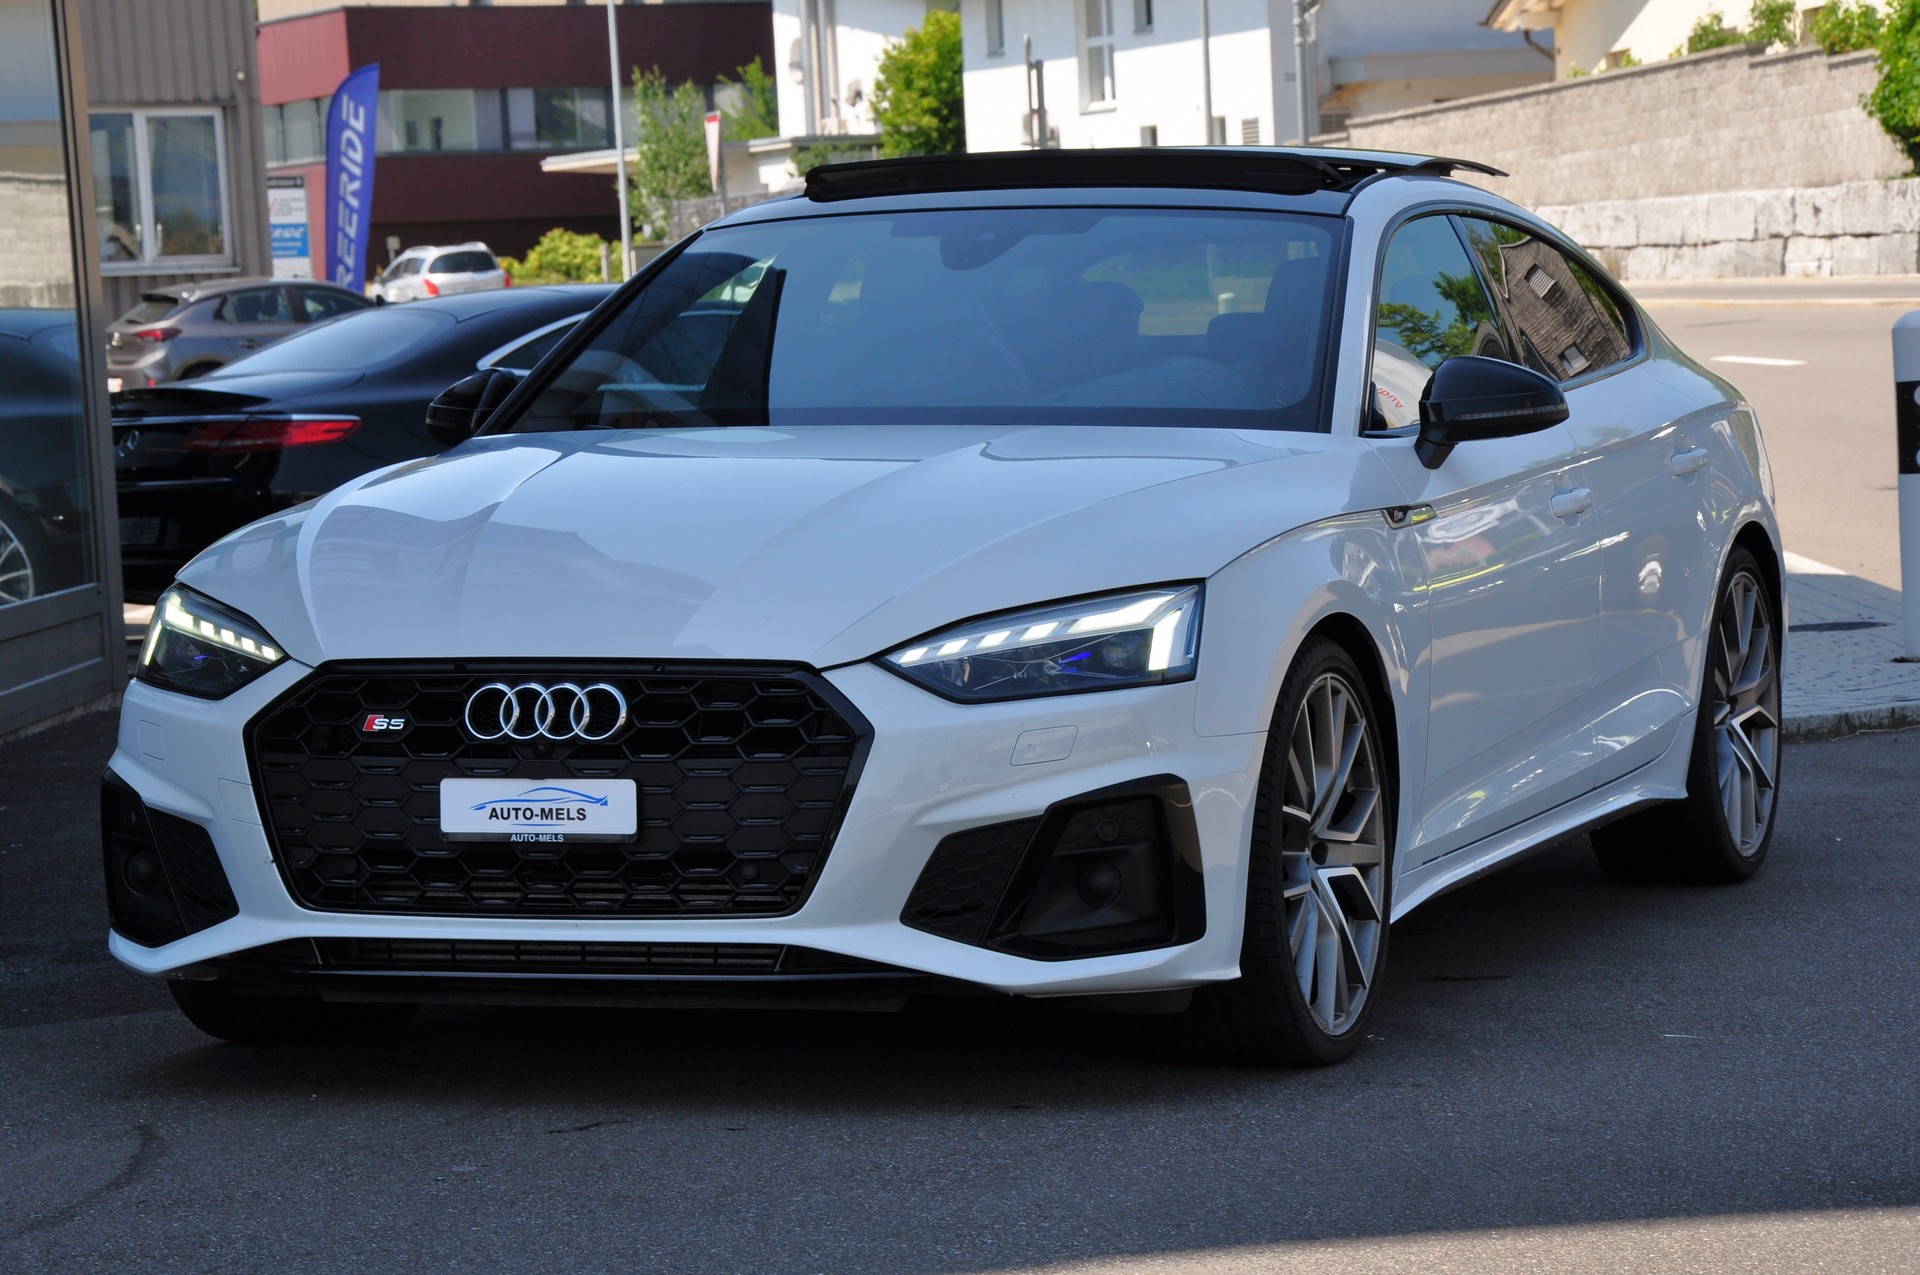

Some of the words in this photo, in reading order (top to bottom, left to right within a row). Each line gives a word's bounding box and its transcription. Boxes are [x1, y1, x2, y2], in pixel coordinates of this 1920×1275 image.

[1377, 388, 1404, 408] Audi
[371, 717, 406, 730] S5
[488, 807, 587, 821] AUTO-MELS
[510, 834, 564, 842] AUTO-MELS
